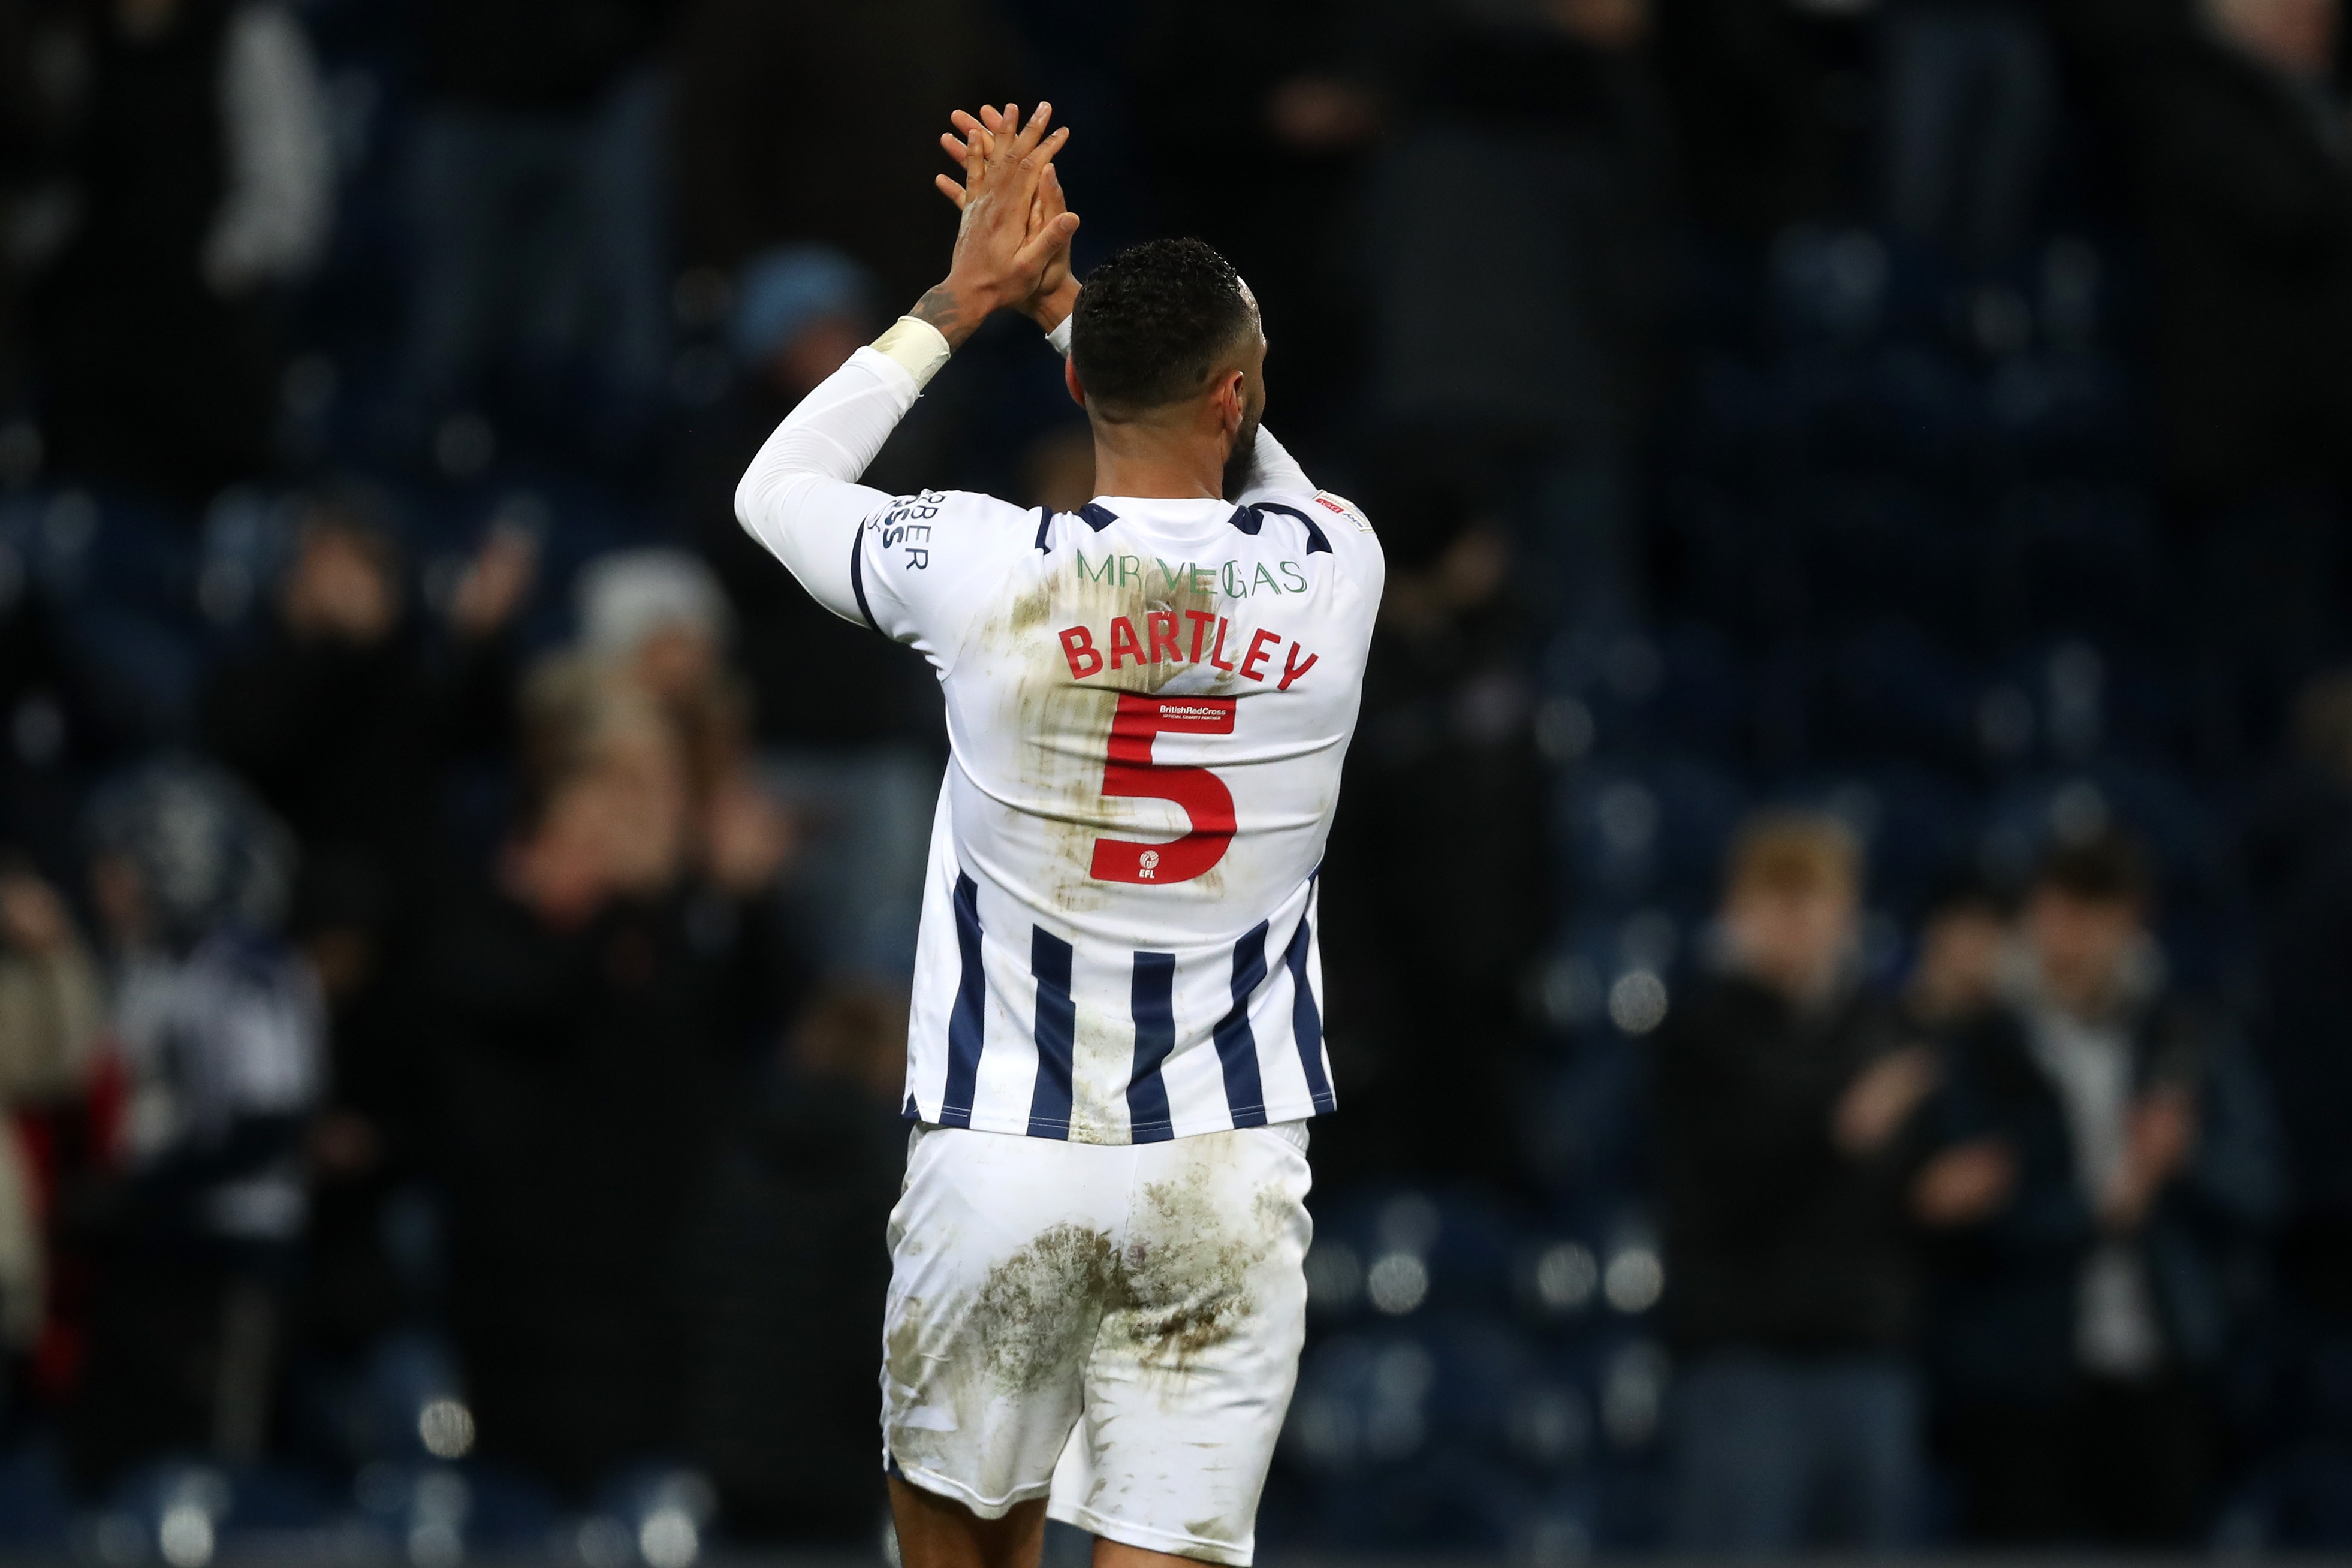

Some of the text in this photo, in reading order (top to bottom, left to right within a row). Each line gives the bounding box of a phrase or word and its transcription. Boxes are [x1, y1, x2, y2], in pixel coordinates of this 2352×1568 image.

[1077, 549, 1307, 598] MR VEGAS
[1059, 610, 1319, 690] BARTLEY
[1160, 705, 1226, 715] BritishRedCross
[1090, 693, 1237, 885] 5
[1139, 869, 1154, 879] EFL
